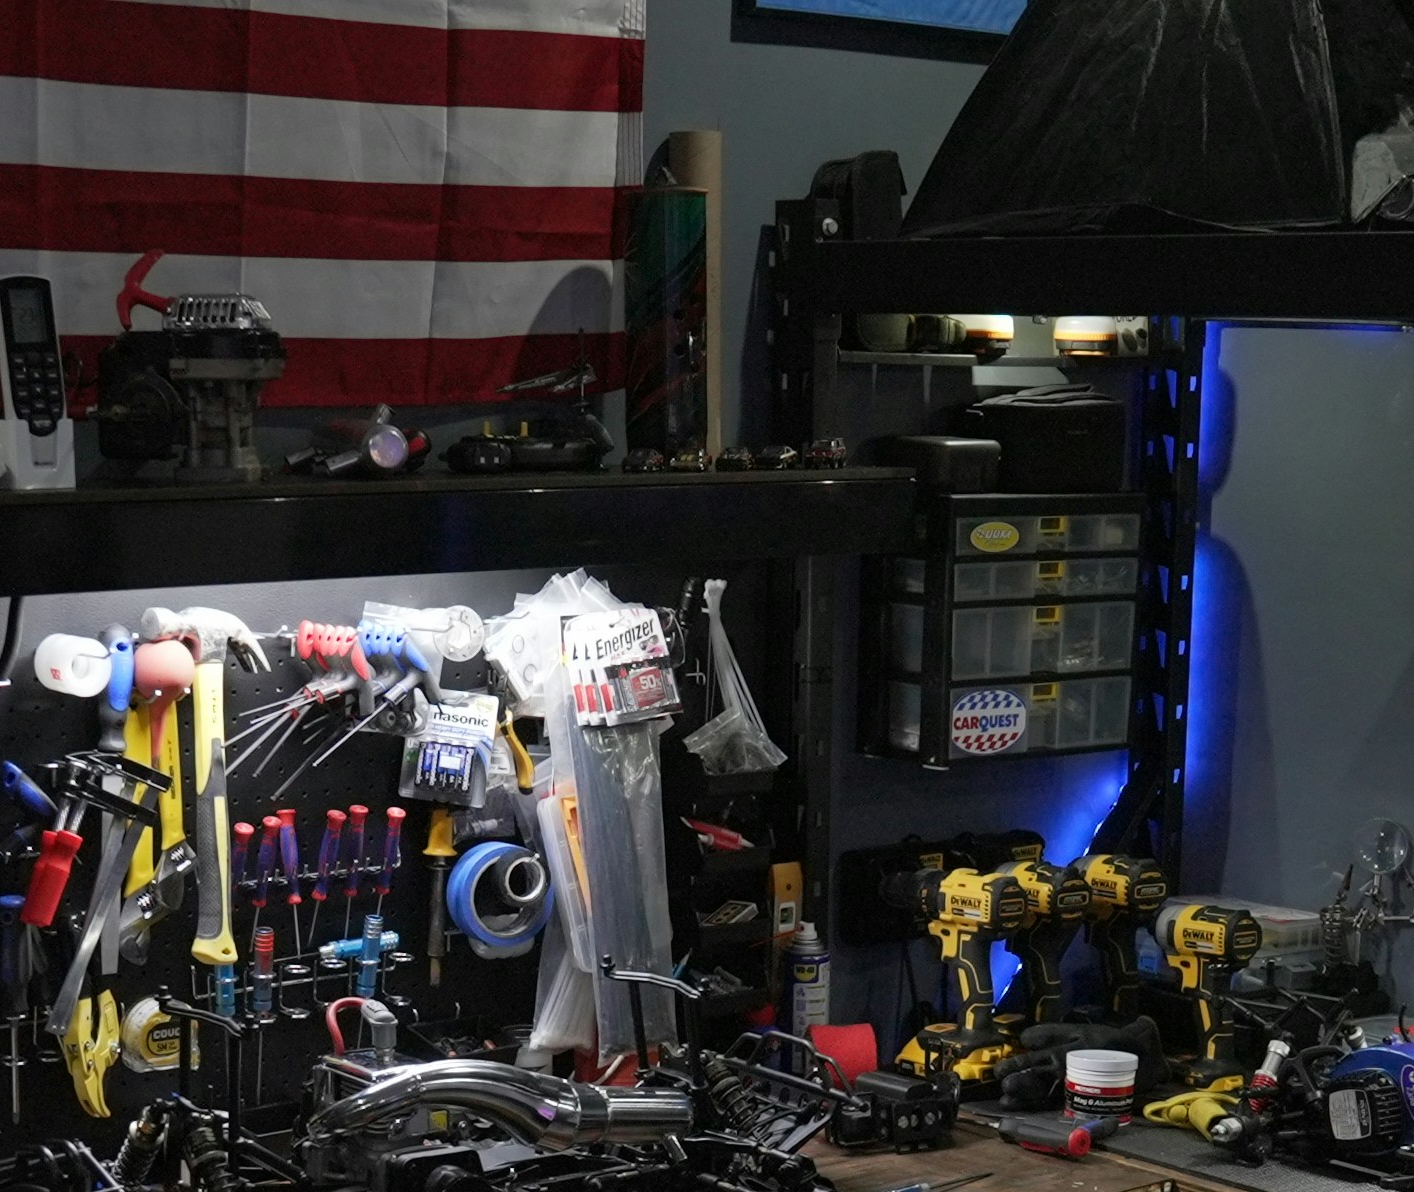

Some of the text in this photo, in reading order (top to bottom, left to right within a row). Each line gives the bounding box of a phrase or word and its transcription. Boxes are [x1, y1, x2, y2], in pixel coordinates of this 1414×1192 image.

[595, 619, 656, 660] Energizer
[433, 710, 490, 728] nasonic
[953, 713, 1020, 733] CARQUEST
[950, 895, 983, 910] DEWALT
[1182, 928, 1215, 942] DEWALT
